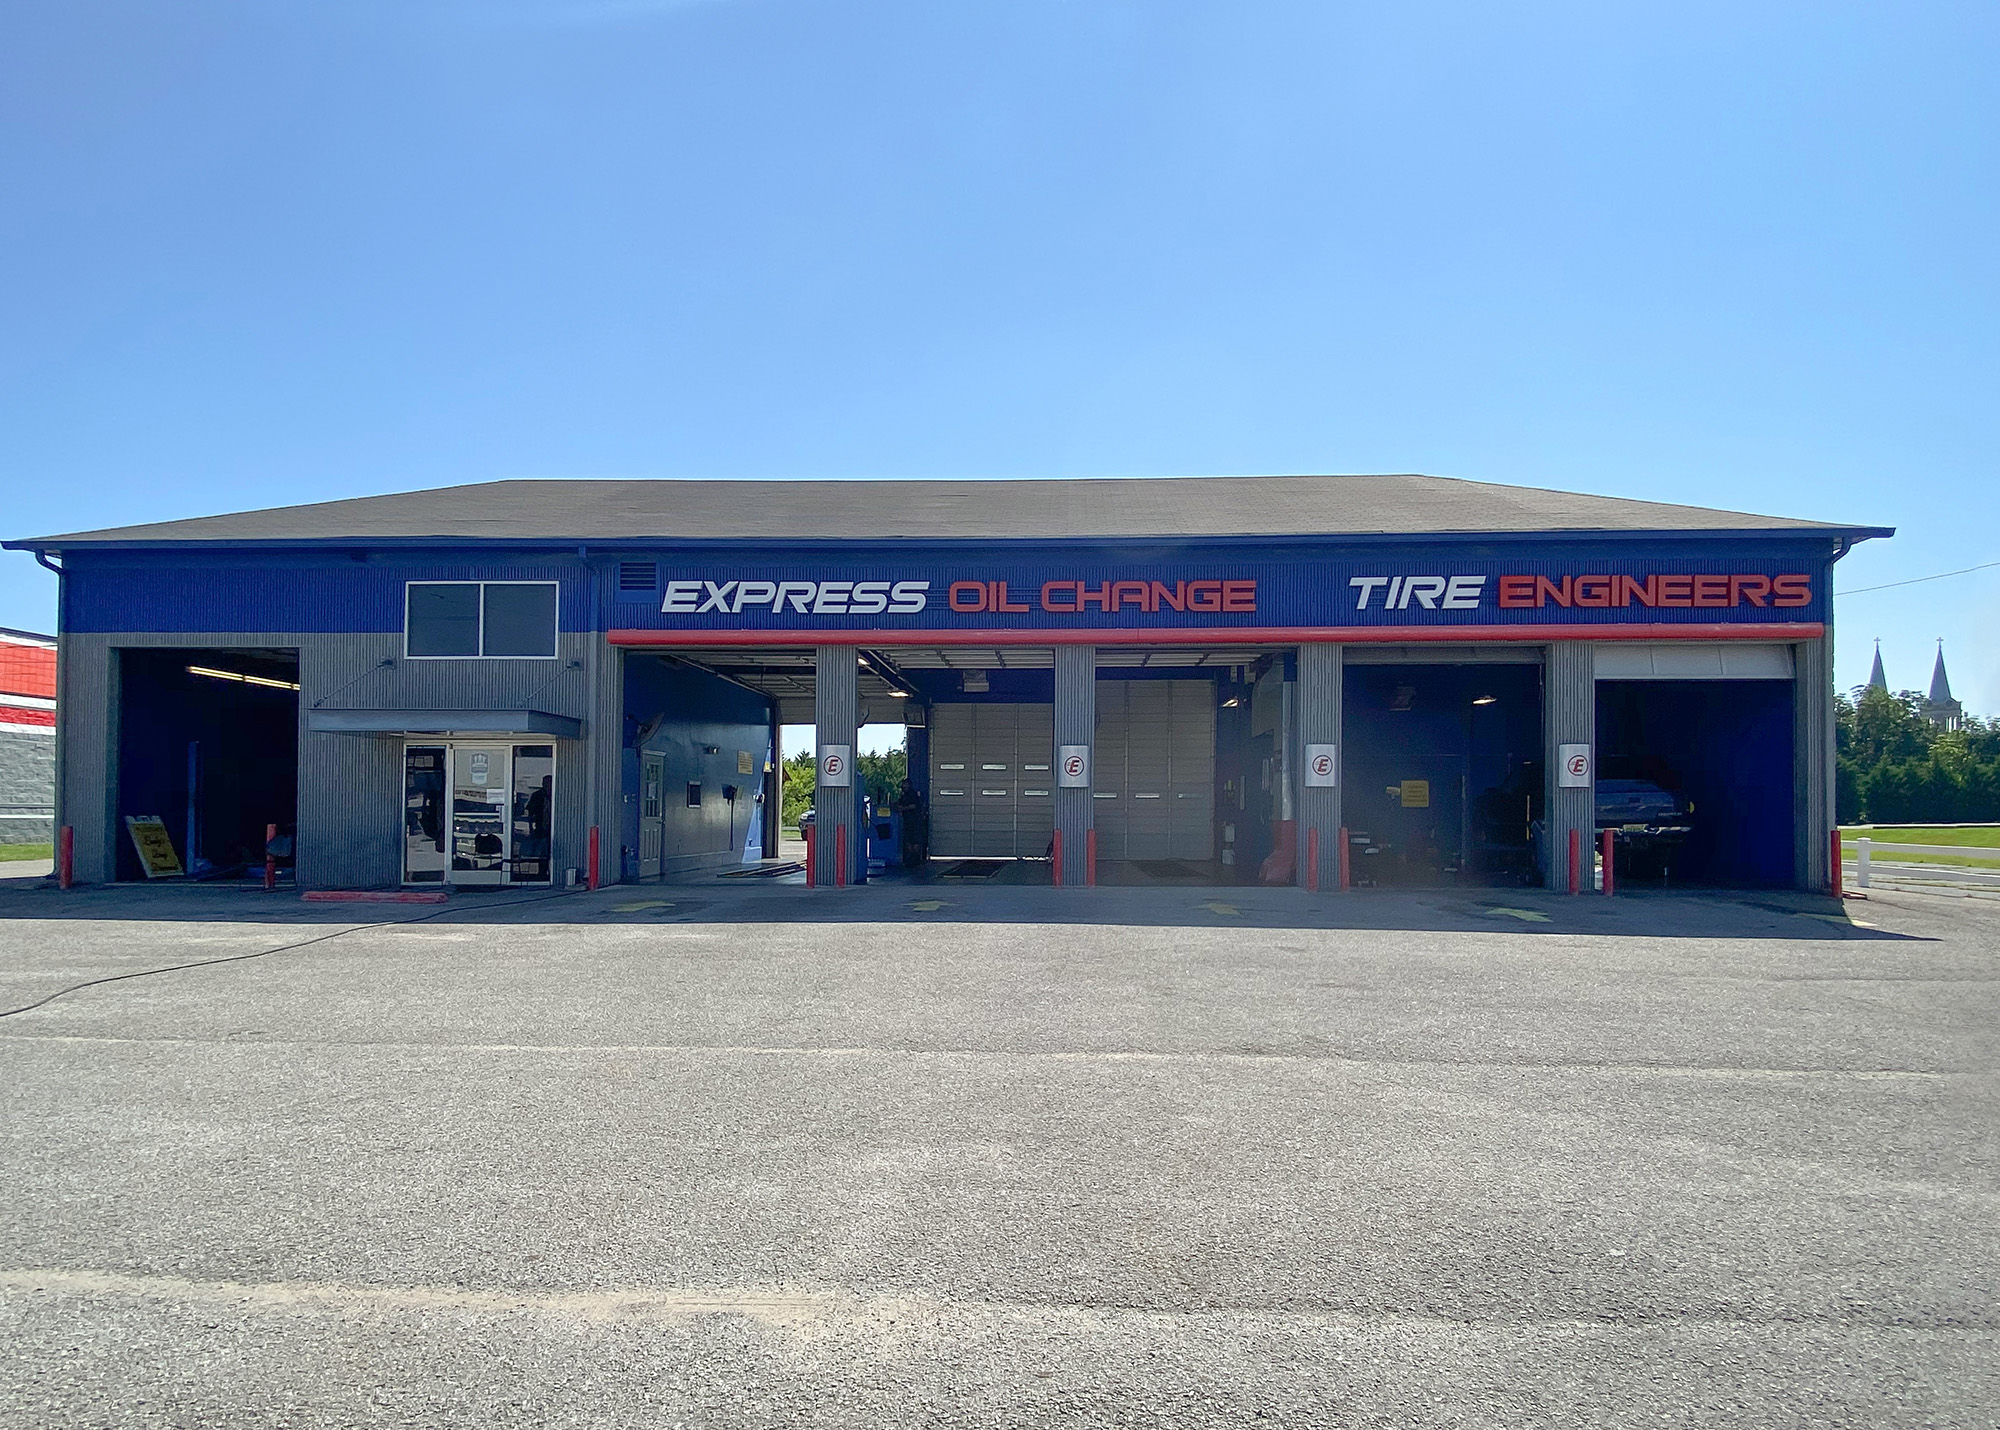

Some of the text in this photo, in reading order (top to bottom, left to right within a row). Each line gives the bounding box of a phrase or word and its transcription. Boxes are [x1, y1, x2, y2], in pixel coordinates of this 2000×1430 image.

[660, 580, 1257, 613] EXPRESS OIL CHANGE
[1349, 574, 1812, 609] TIRE ENGINEERS
